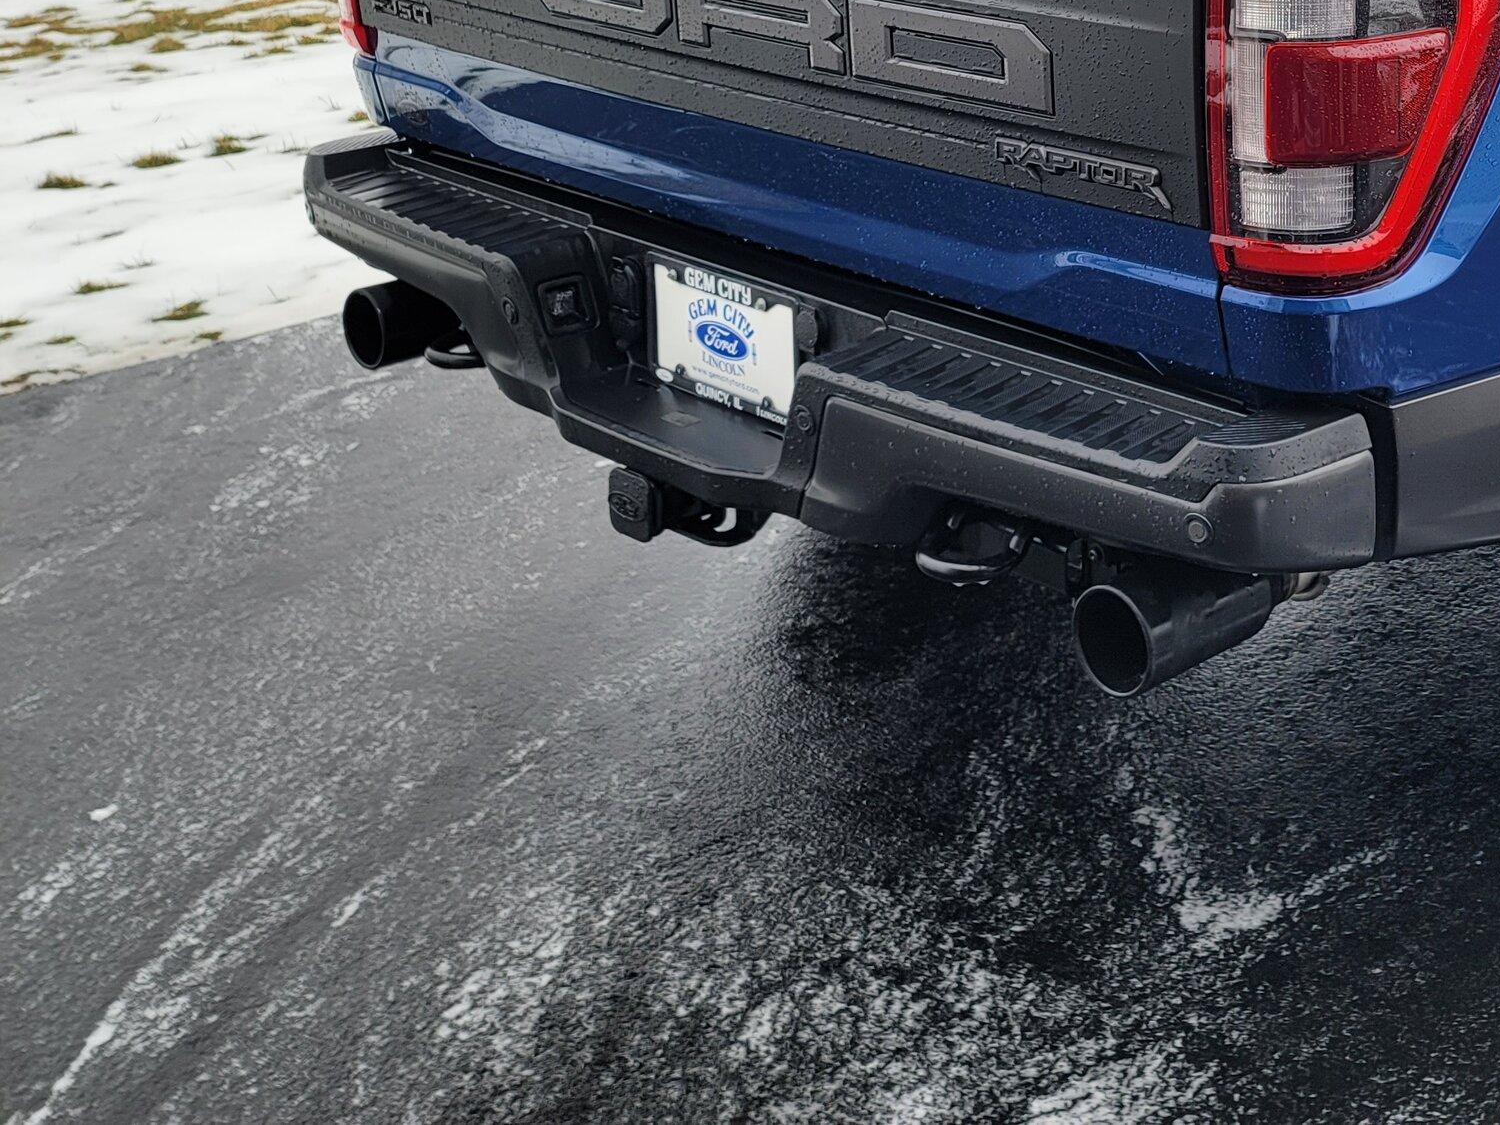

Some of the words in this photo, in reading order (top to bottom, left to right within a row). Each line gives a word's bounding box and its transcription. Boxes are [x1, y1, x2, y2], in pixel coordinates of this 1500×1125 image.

[994, 134, 1173, 213] RAPTOR
[684, 266, 716, 295] GEM
[717, 278, 753, 306] CITY
[688, 298, 718, 320] GEM
[723, 304, 755, 340] CITY
[704, 325, 740, 355] Ford
[701, 350, 746, 376] LINCOLN
[695, 382, 732, 408] QUINCY,
[732, 395, 744, 411] IL
